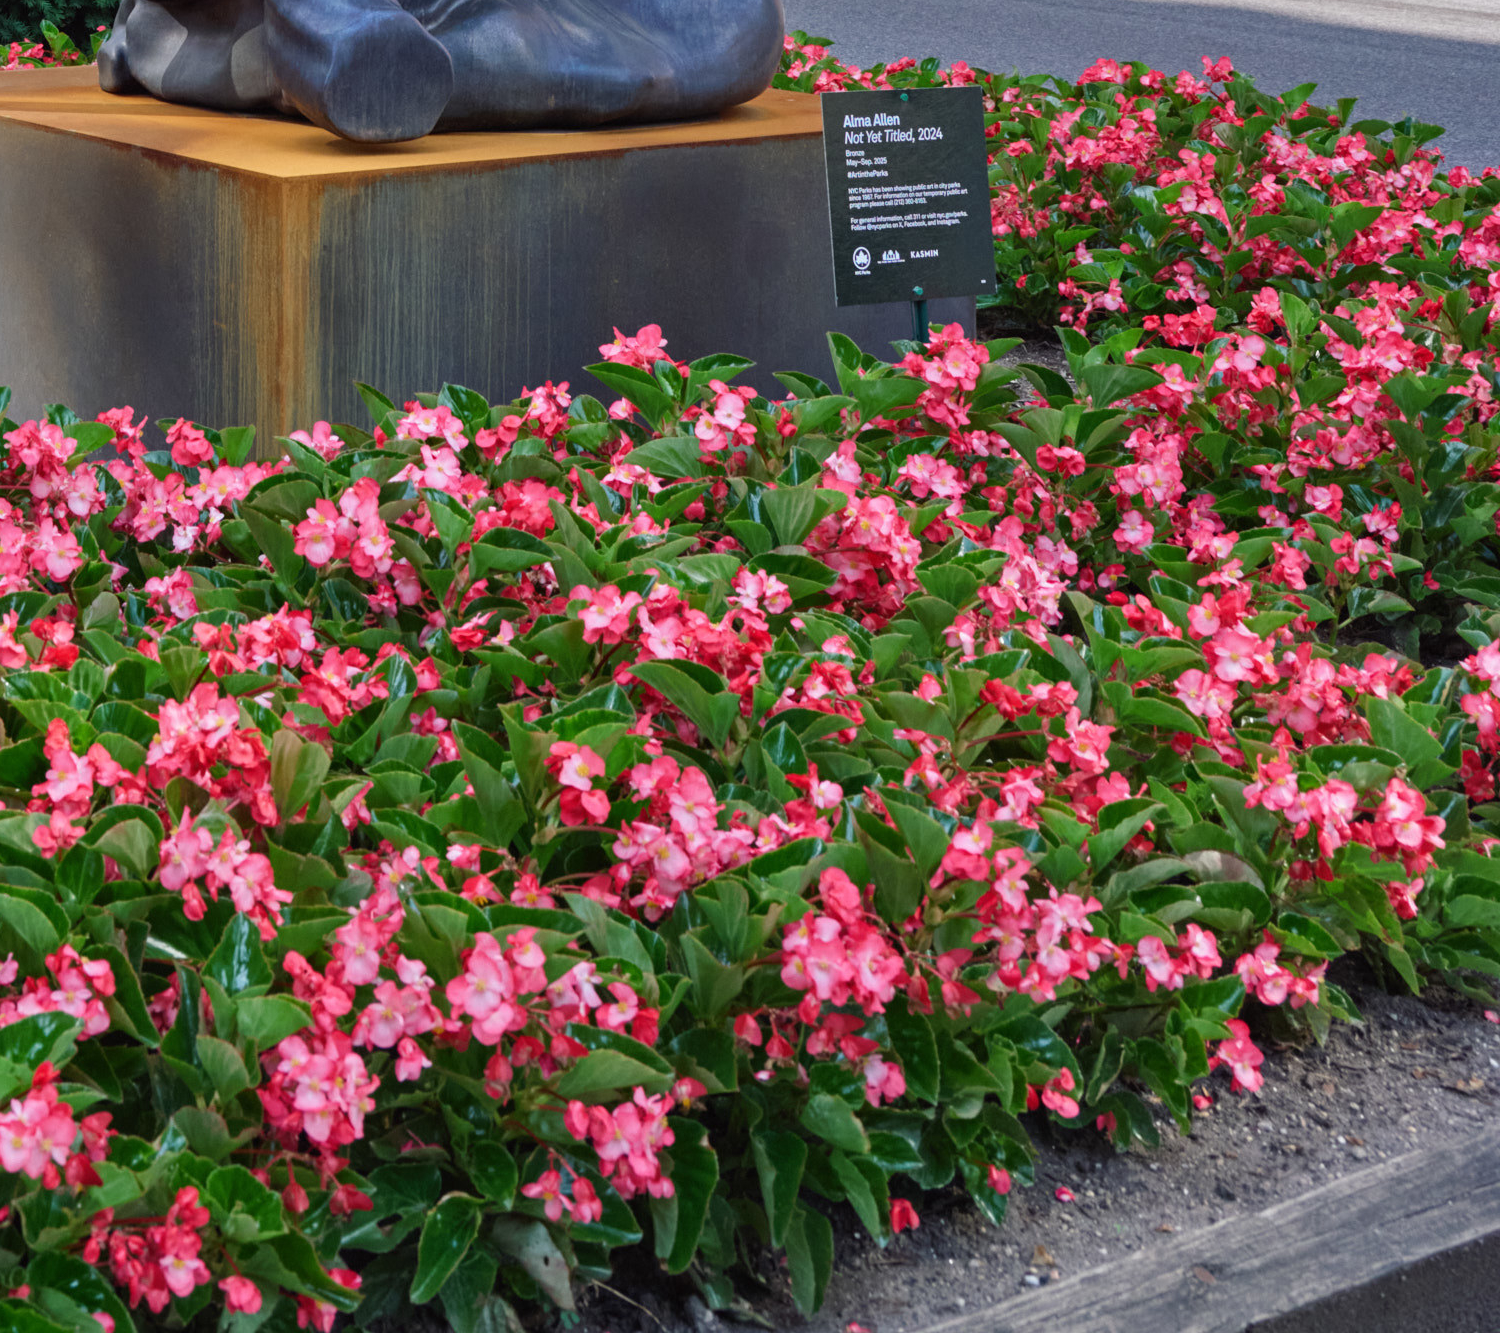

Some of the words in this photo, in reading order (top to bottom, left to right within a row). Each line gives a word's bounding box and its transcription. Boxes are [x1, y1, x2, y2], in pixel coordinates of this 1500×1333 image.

[843, 114, 871, 128] Alma
[873, 113, 900, 126] Allen
[844, 131, 864, 144] Not
[866, 130, 882, 143] Yet
[884, 128, 915, 143] Titled,
[918, 127, 943, 141] 2024
[847, 170, 888, 178] #ArtintheParks
[859, 216, 876, 225] general
[867, 223, 892, 231] @nycparks
[910, 249, 939, 259] KASMIN
